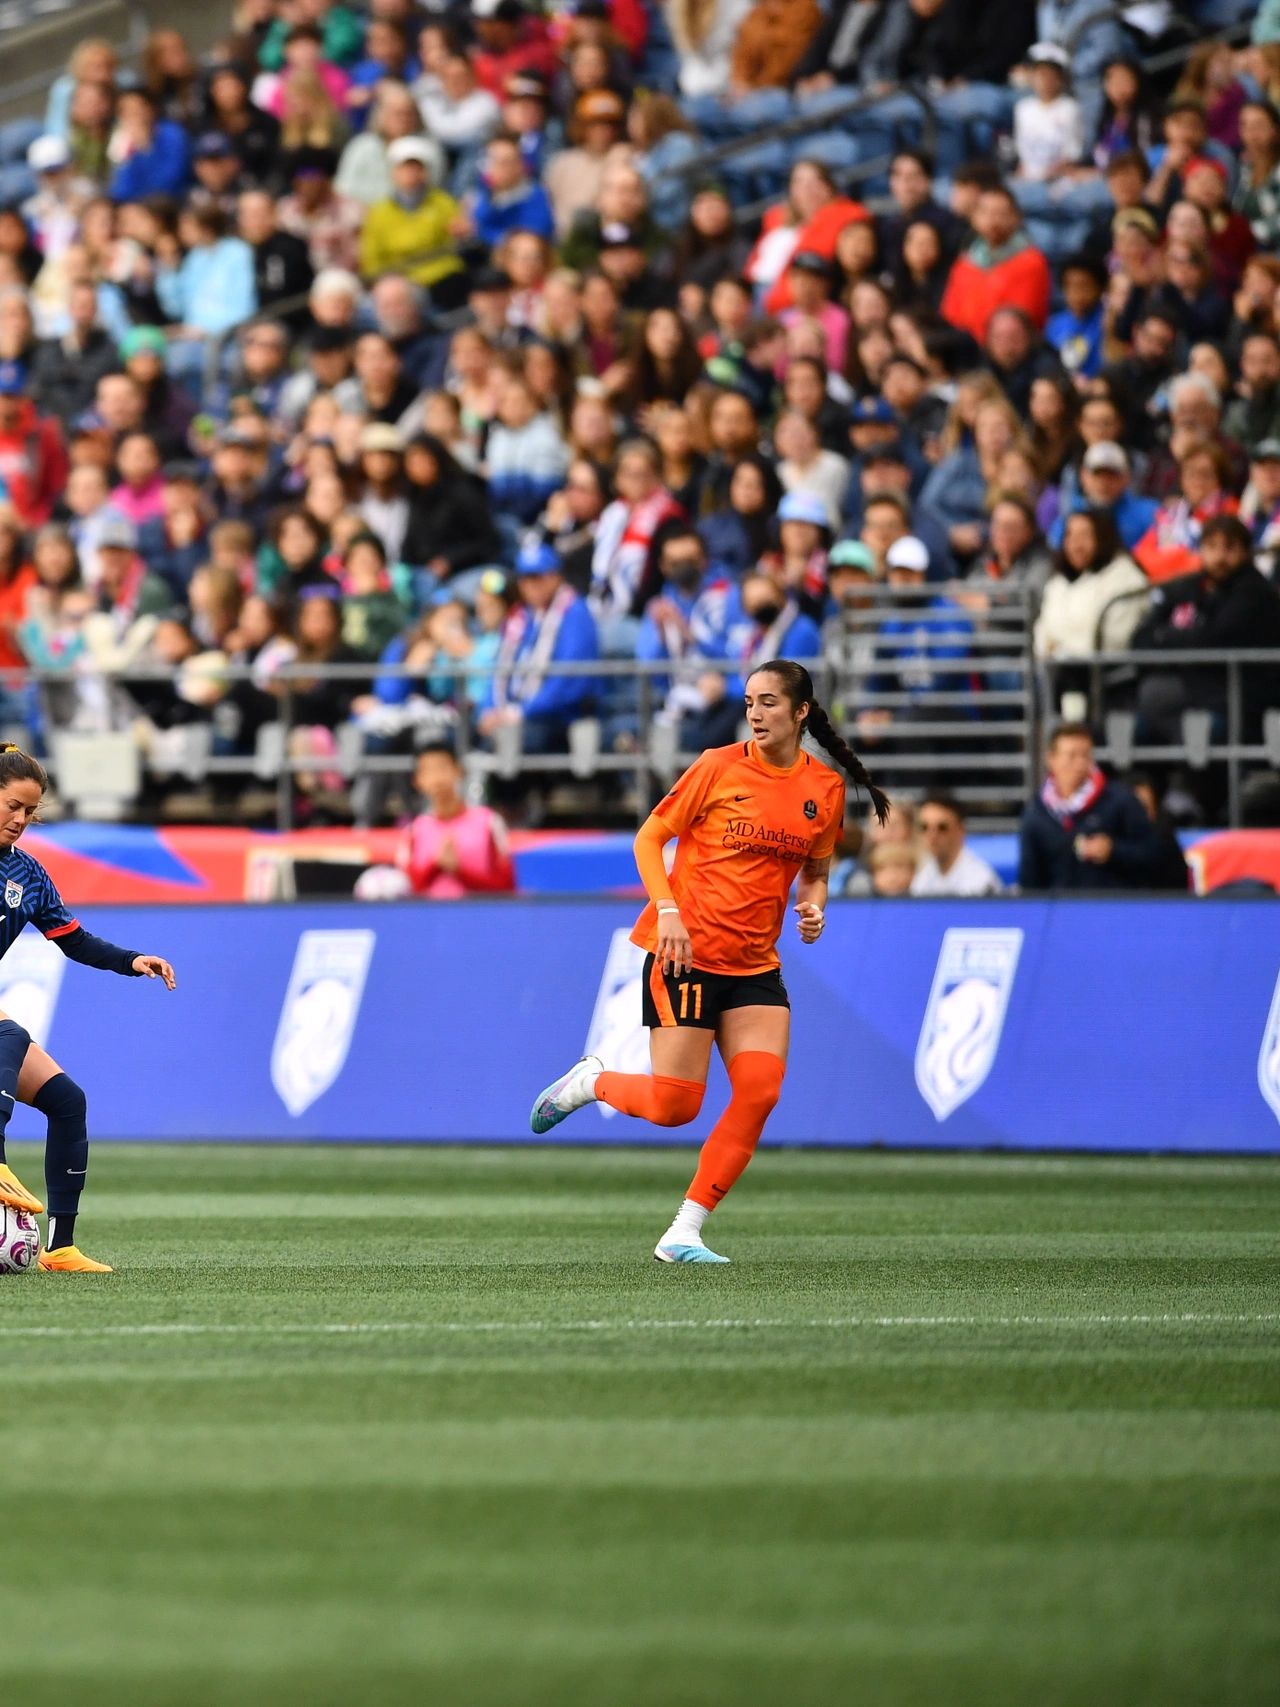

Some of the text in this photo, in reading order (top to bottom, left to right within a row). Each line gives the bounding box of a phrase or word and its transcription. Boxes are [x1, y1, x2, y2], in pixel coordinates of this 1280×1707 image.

[725, 820, 754, 837] MD
[722, 834, 772, 857] Cancer
[679, 982, 702, 1020] 11
